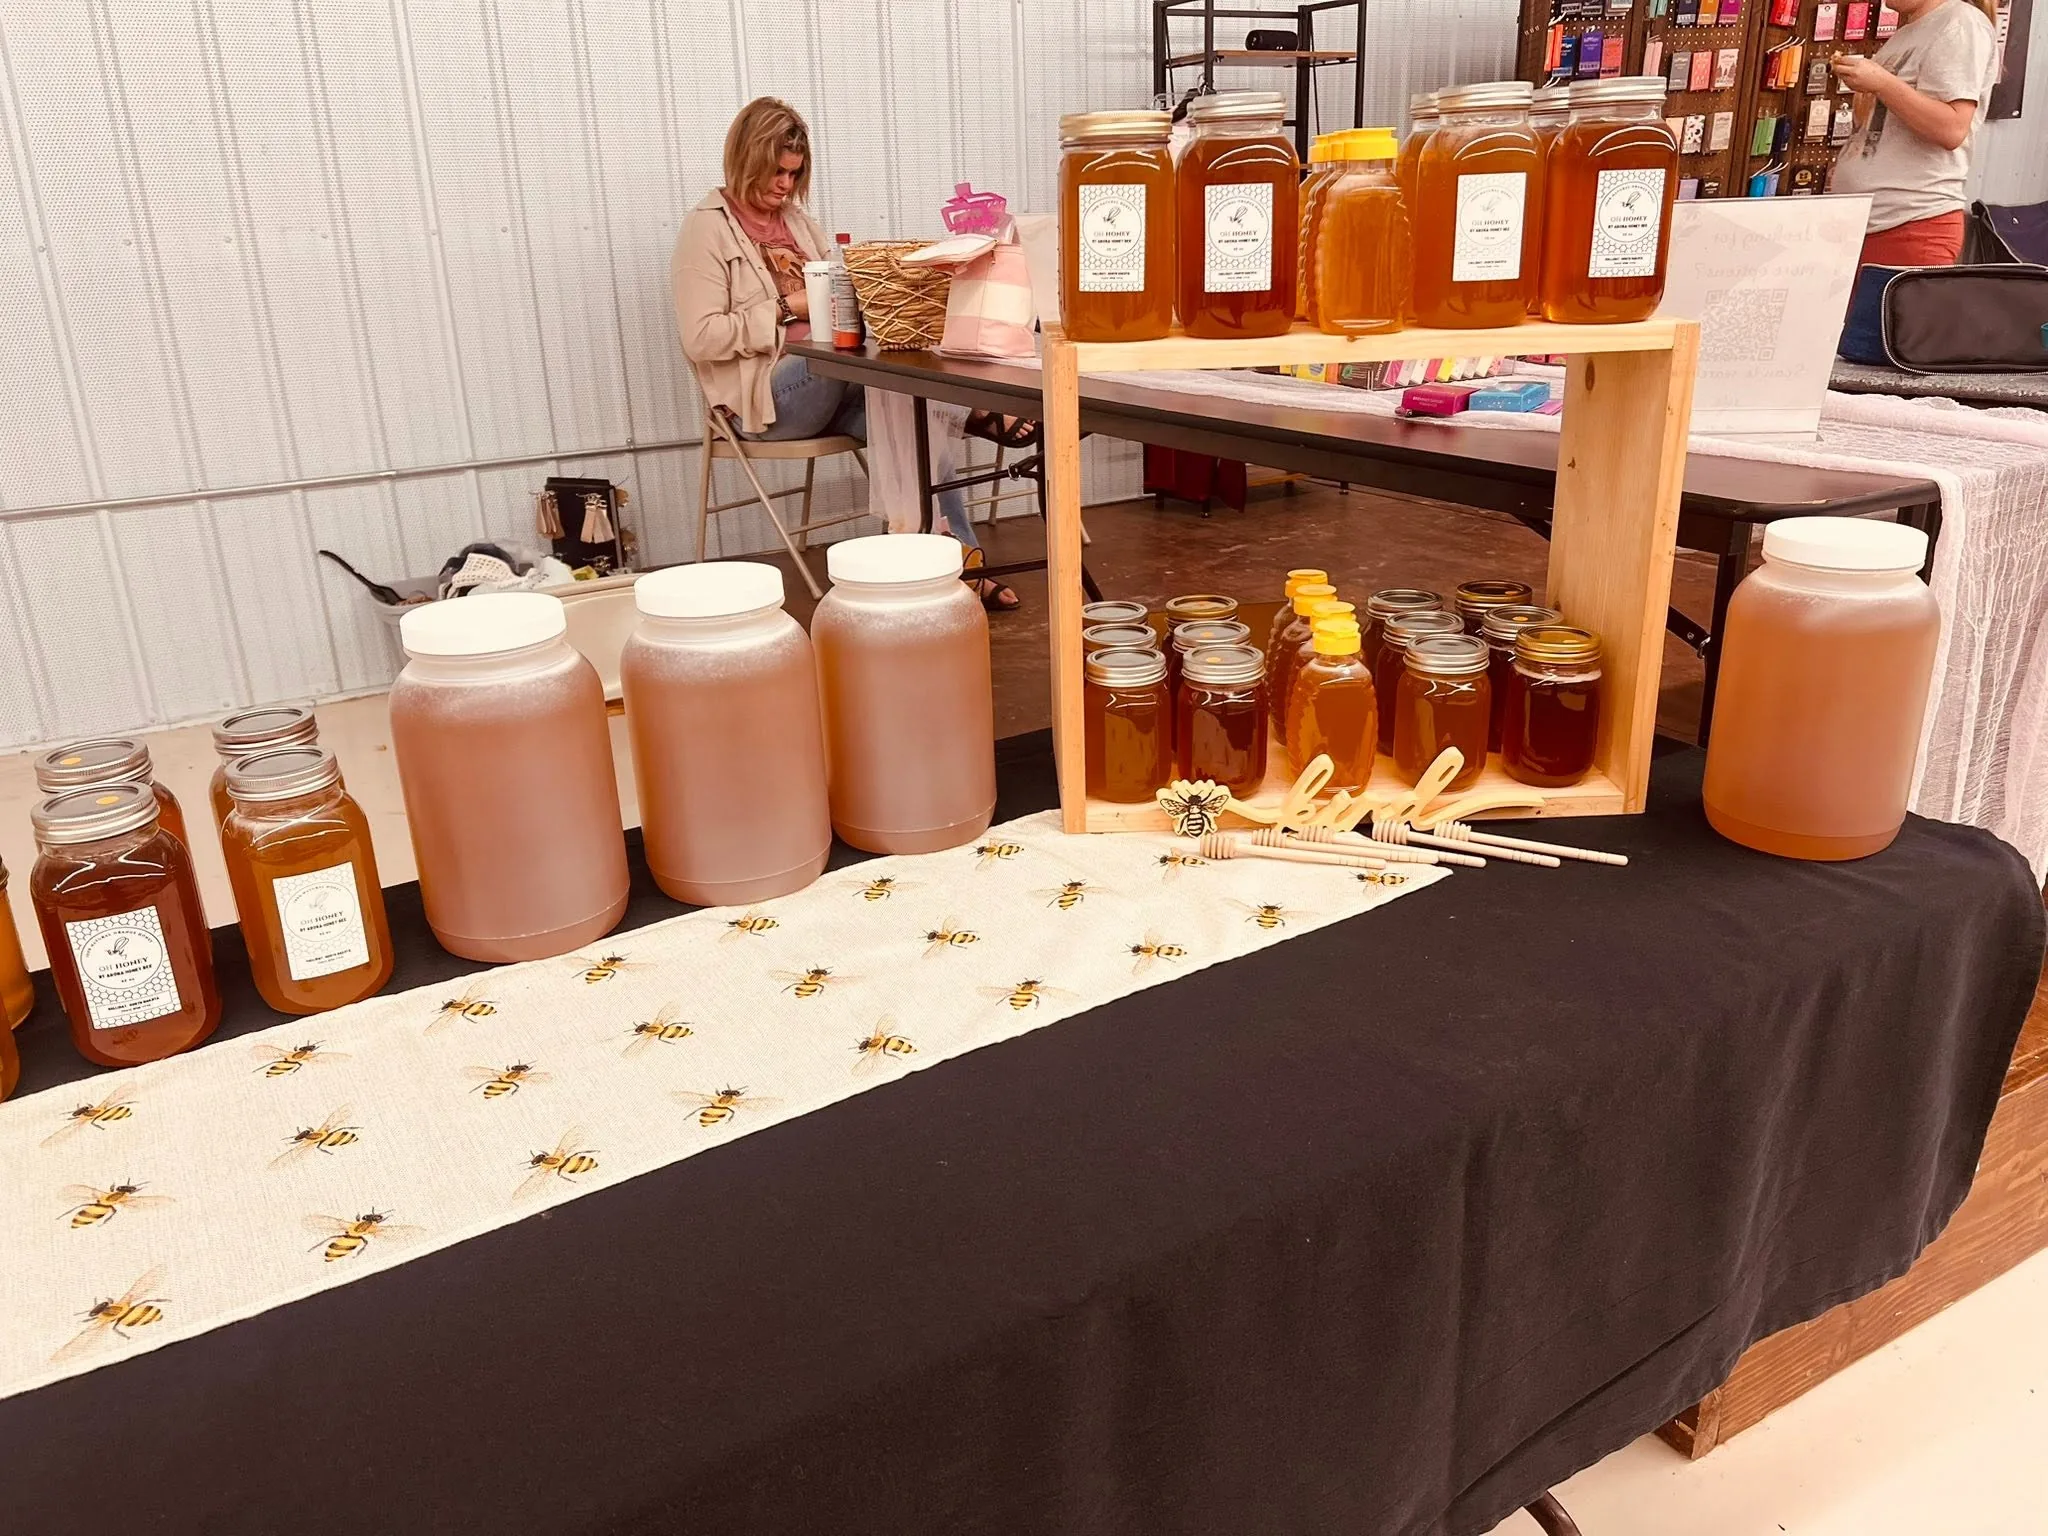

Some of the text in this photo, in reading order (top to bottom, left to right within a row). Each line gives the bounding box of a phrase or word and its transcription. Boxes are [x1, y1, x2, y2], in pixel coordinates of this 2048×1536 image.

[1270, 746, 1480, 833] kind
[300, 910, 344, 926] OH HONEY
[98, 956, 149, 972] OH HONEY
[125, 967, 142, 976] HONEY
